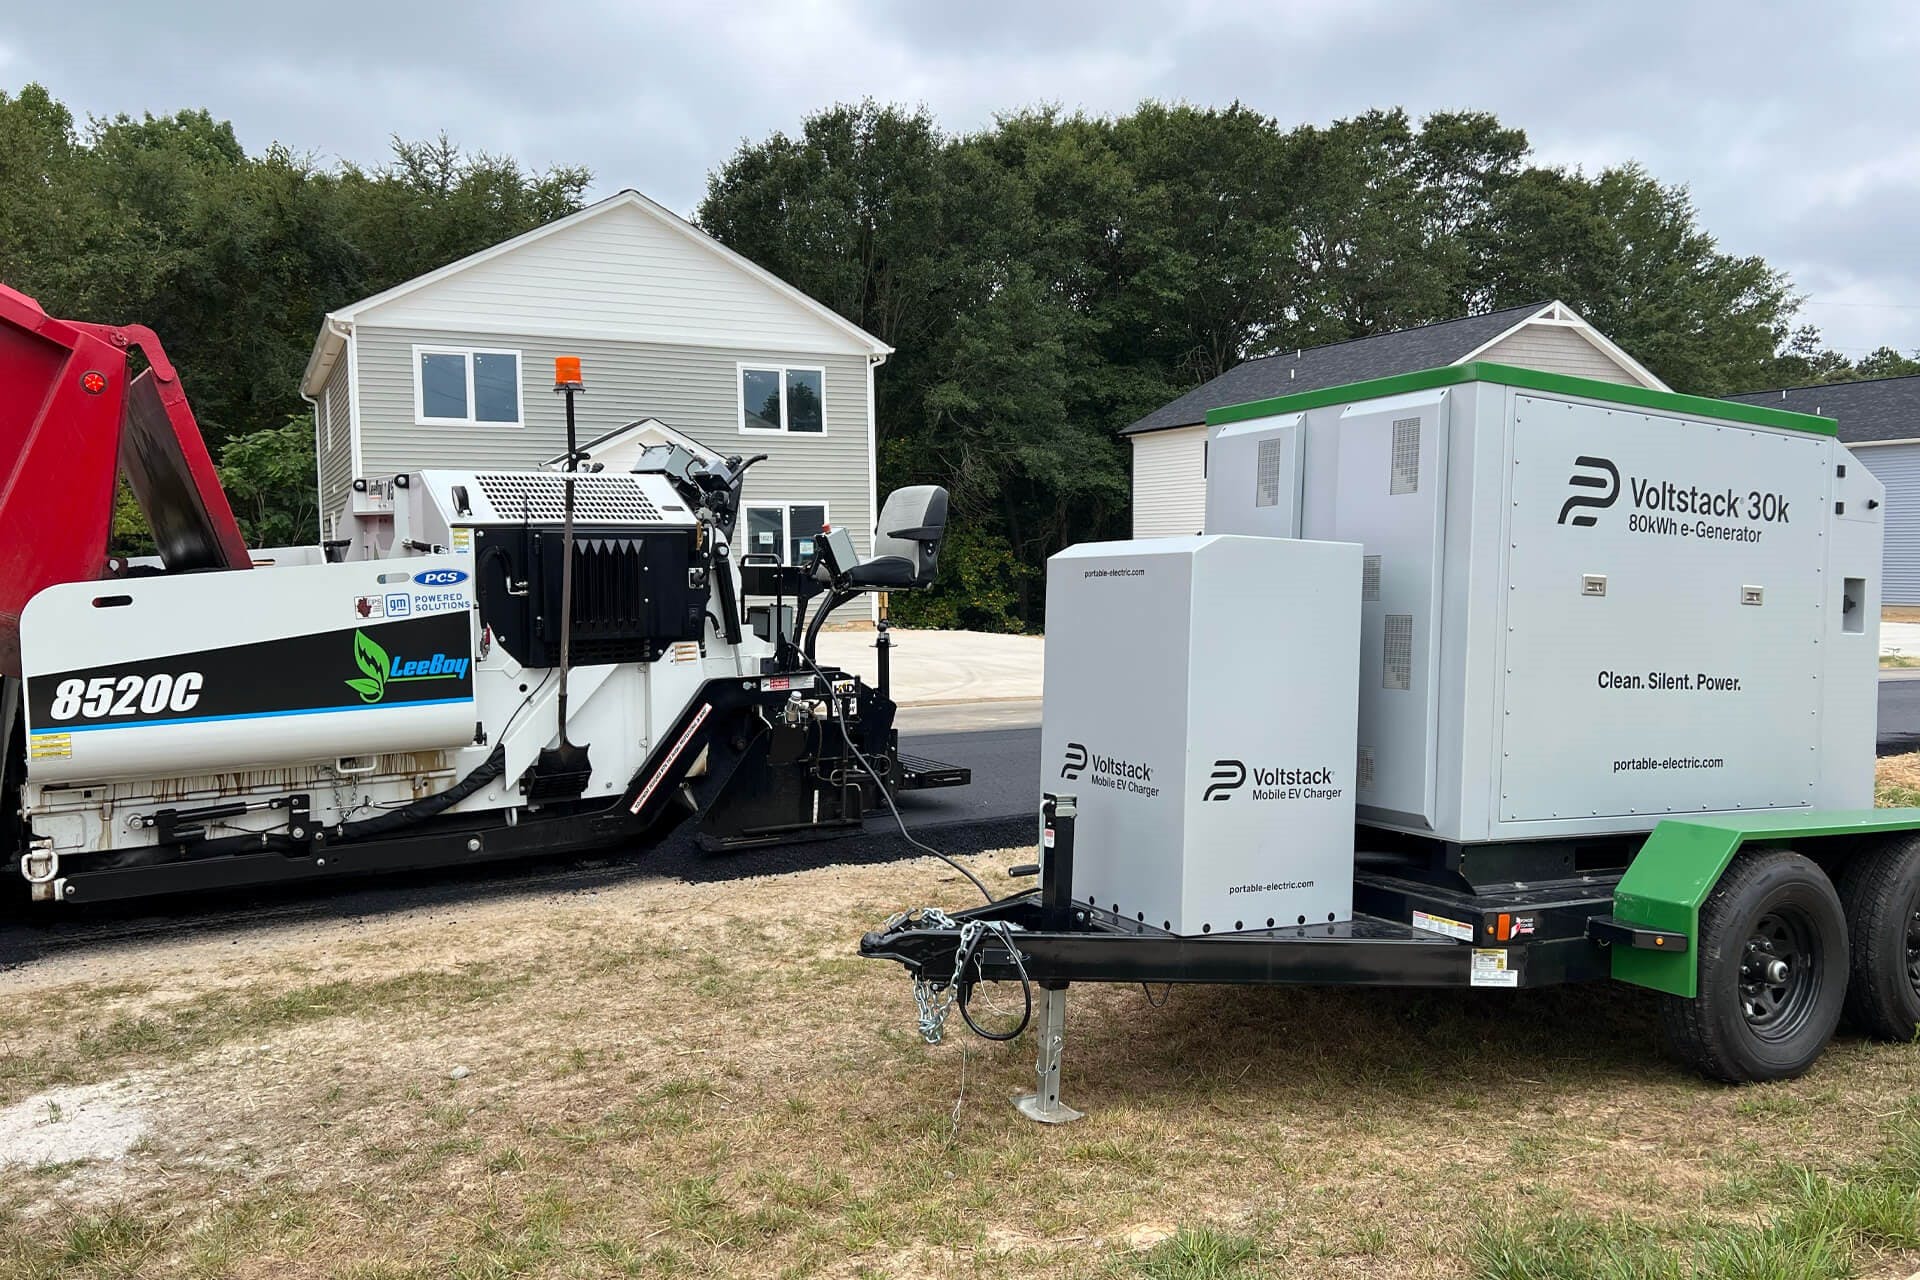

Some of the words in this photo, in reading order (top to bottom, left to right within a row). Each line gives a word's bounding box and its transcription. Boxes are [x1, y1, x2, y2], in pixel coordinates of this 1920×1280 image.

[1630, 477, 1739, 518] Voltstack
[1747, 491, 1790, 524] 30k
[1629, 514, 1677, 536] 80kWh
[1680, 521, 1762, 543] e-Generator
[424, 573, 458, 584] PCS
[1084, 568, 1145, 578] portable-electric.com
[389, 599, 406, 611] gm
[415, 593, 463, 603] POWERED
[415, 601, 470, 611] SOLUTIONS
[390, 653, 469, 679] LeeBoy
[1598, 671, 1645, 689] Clean.
[1648, 672, 1694, 690] Silent.
[1697, 673, 1741, 691] Power.
[50, 672, 204, 720] 8520C
[1092, 754, 1152, 781] Voltstack
[1613, 756, 1724, 773] portable-electric.com
[1253, 766, 1332, 786] Voltstack
[1092, 774, 1116, 788] Mobile
[1117, 779, 1127, 790] EV
[1128, 781, 1159, 798] Charger
[1252, 789, 1287, 800] Mobile
[1288, 788, 1301, 799] EV
[1303, 788, 1342, 800] Charger
[1229, 880, 1314, 896] portable-electric.com
